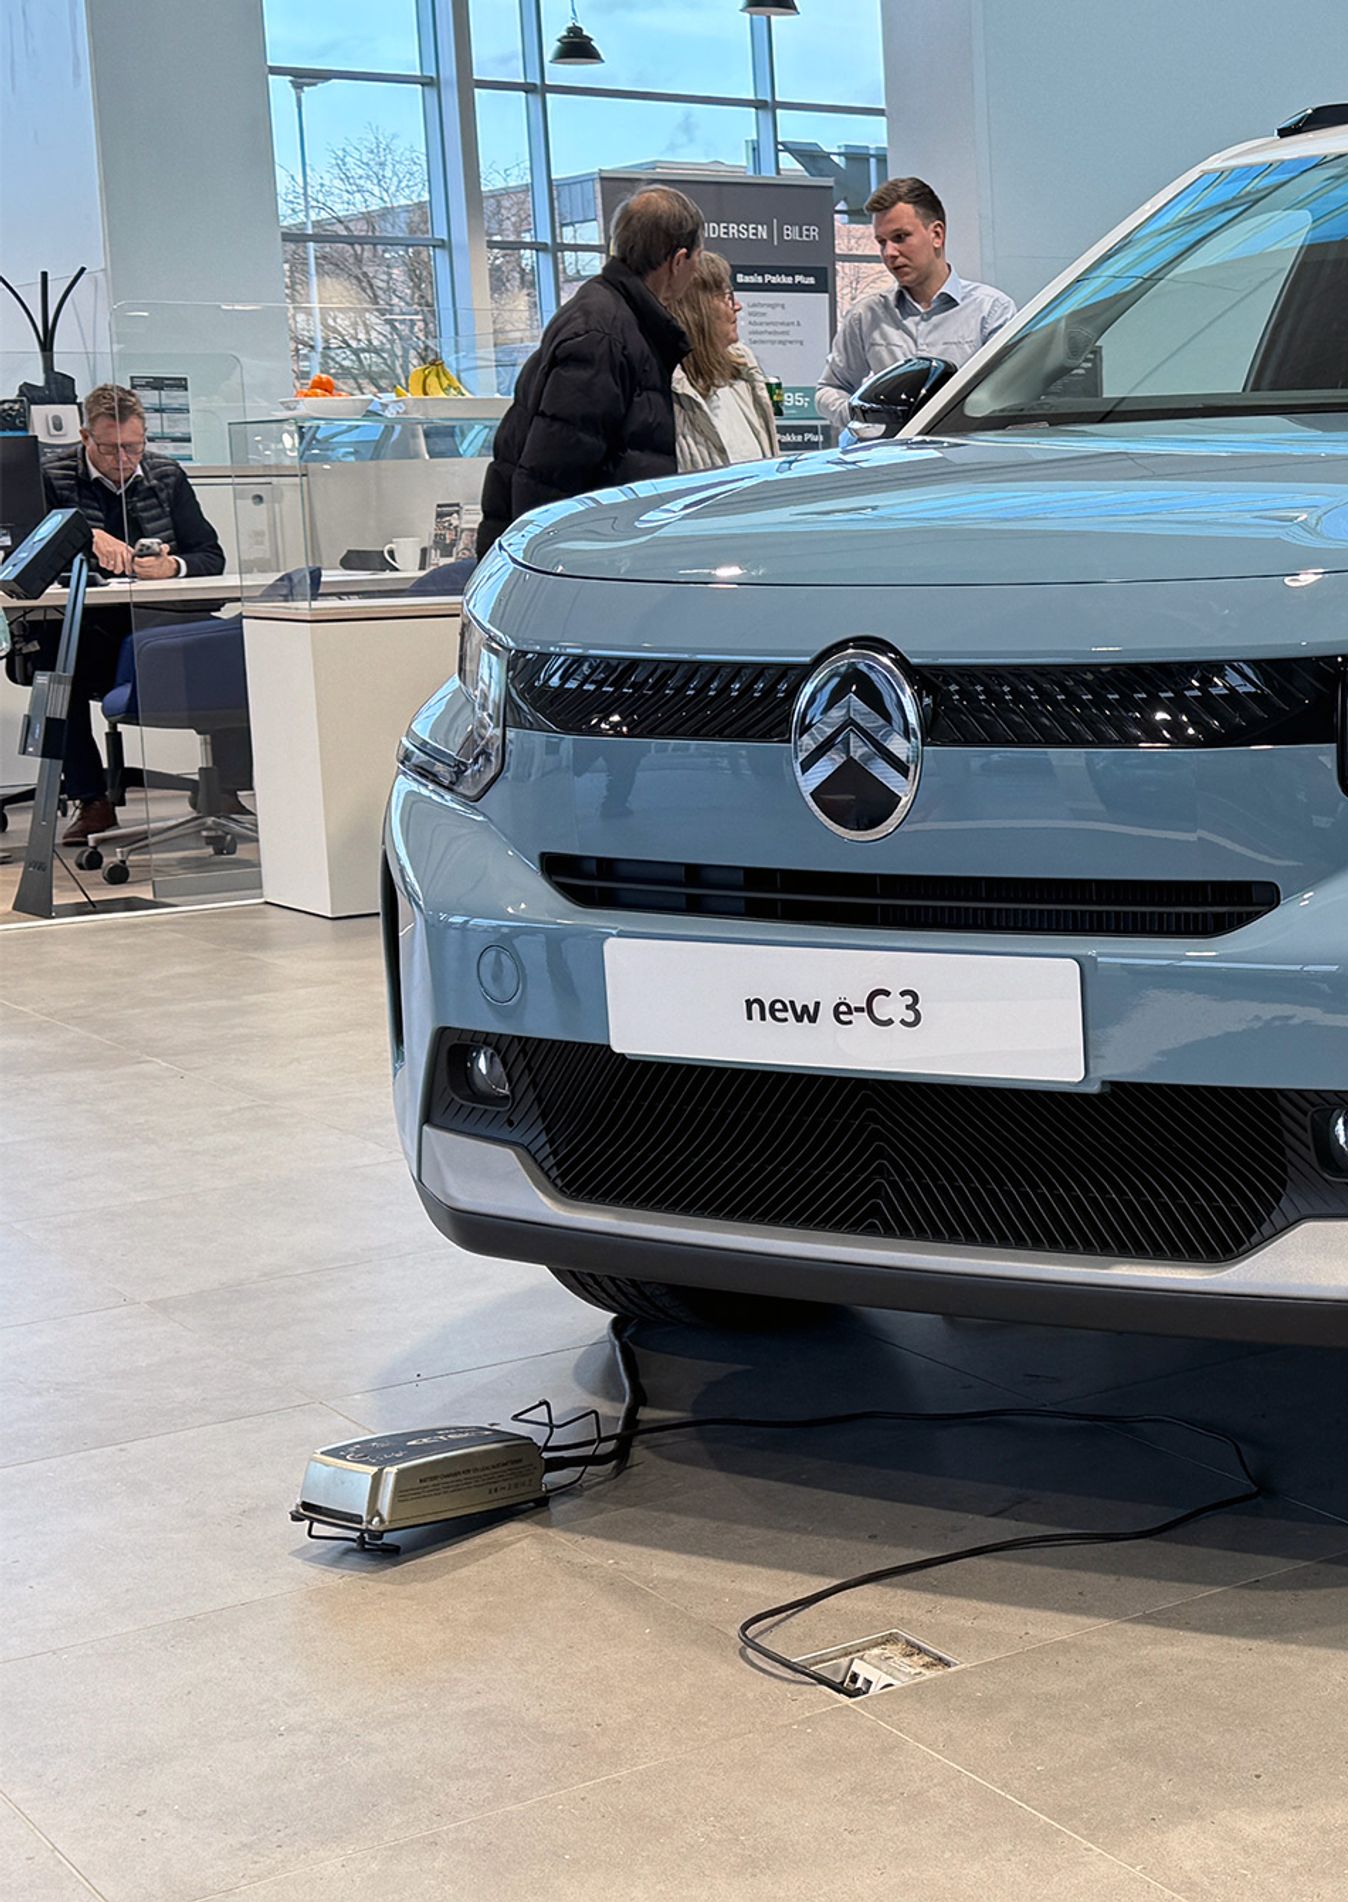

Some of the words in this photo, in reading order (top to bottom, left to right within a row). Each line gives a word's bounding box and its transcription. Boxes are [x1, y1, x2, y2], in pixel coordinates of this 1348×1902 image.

[783, 225, 819, 241] BILER
[764, 274, 793, 284] Pakke
[795, 275, 816, 285] Plus
[744, 997, 821, 1024] new
[833, 988, 922, 1028] ë-C3
